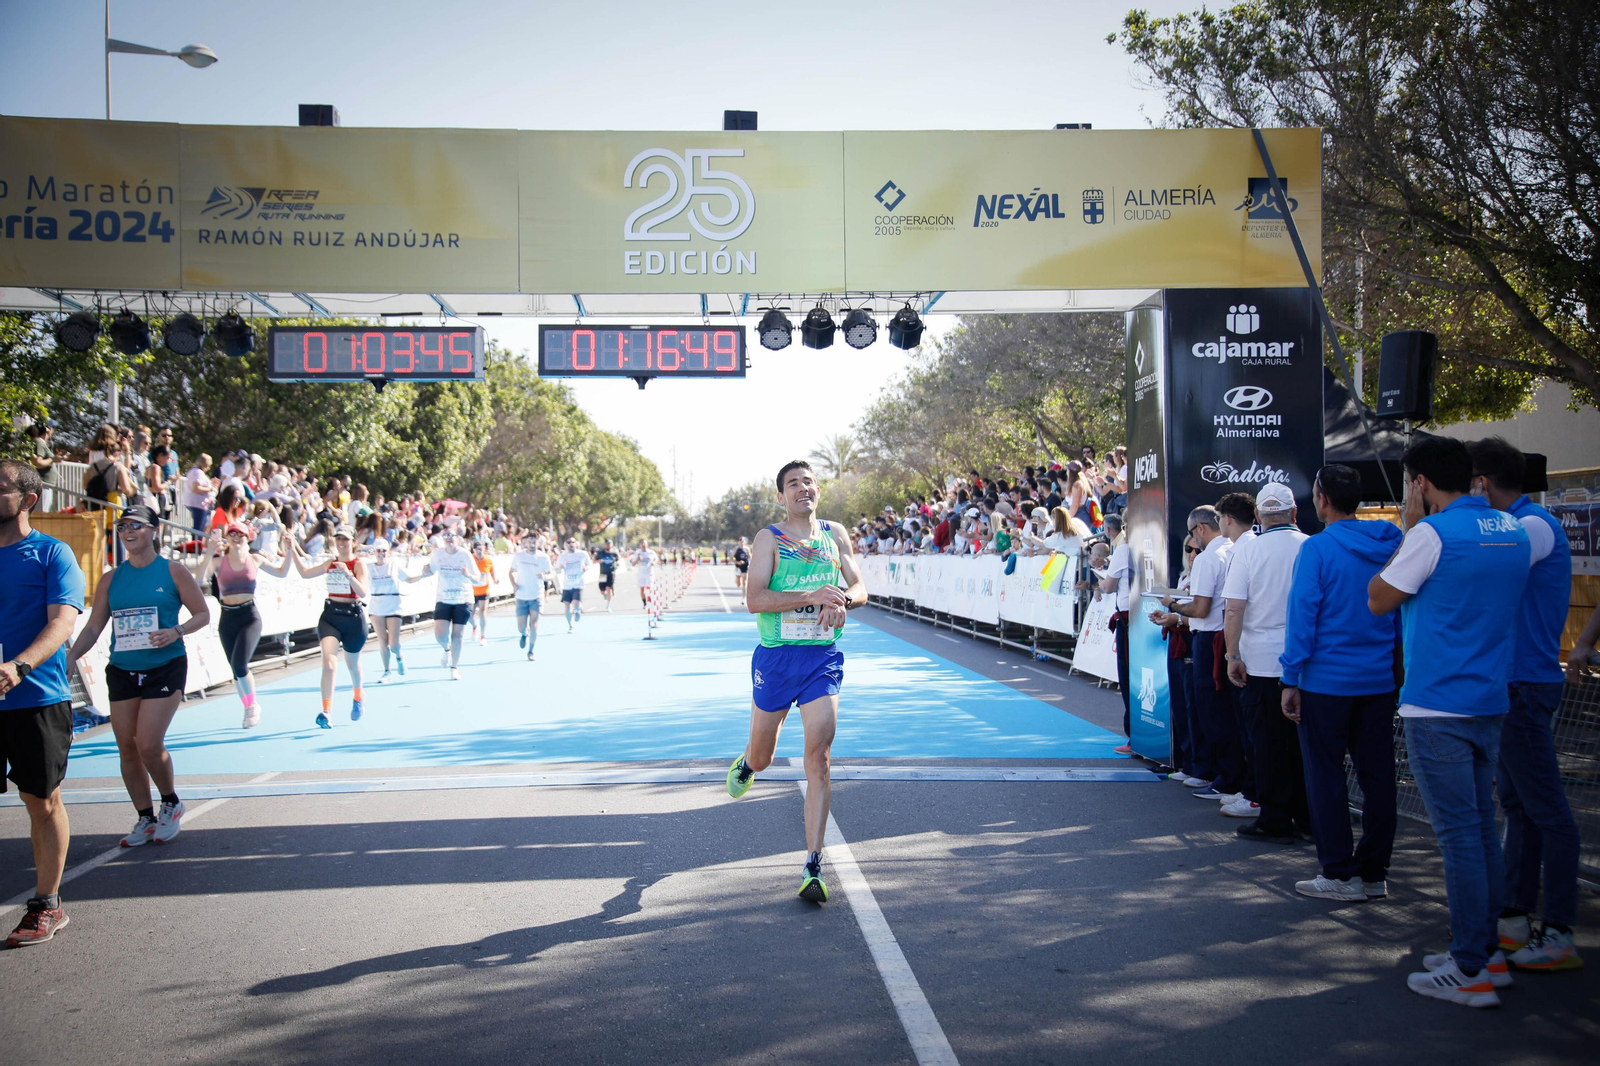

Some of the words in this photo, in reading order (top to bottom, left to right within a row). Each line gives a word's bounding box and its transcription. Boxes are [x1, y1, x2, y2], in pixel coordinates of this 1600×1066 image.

[27, 174, 174, 205] Maratón
[267, 189, 320, 202] RFEA
[623, 147, 756, 242] 25
[1124, 185, 1216, 206] ALMERÍA
[261, 202, 315, 213] SERIES
[1123, 209, 1172, 221] CIUDAD
[0, 205, 58, 240] ría
[68, 209, 175, 243] 2024
[257, 212, 291, 222] RUTA
[293, 212, 346, 222] RUNNING
[874, 213, 954, 226] COOPERACIÓN
[198, 226, 283, 246] RAMÓN
[293, 231, 345, 247] RUIZ
[354, 229, 460, 248] ANDÚJAR
[874, 226, 902, 236] 2005
[624, 245, 757, 275] EDICIÓN
[303, 331, 473, 374] 01:03:45
[571, 329, 737, 372] 01:16:49
[1191, 335, 1295, 364] cajamar
[1241, 358, 1263, 366] CAJA
[1264, 358, 1293, 366] RURAL
[1213, 414, 1282, 426] HYUNDAI
[1216, 427, 1280, 438] Almerialva
[118, 614, 154, 631] 5125
